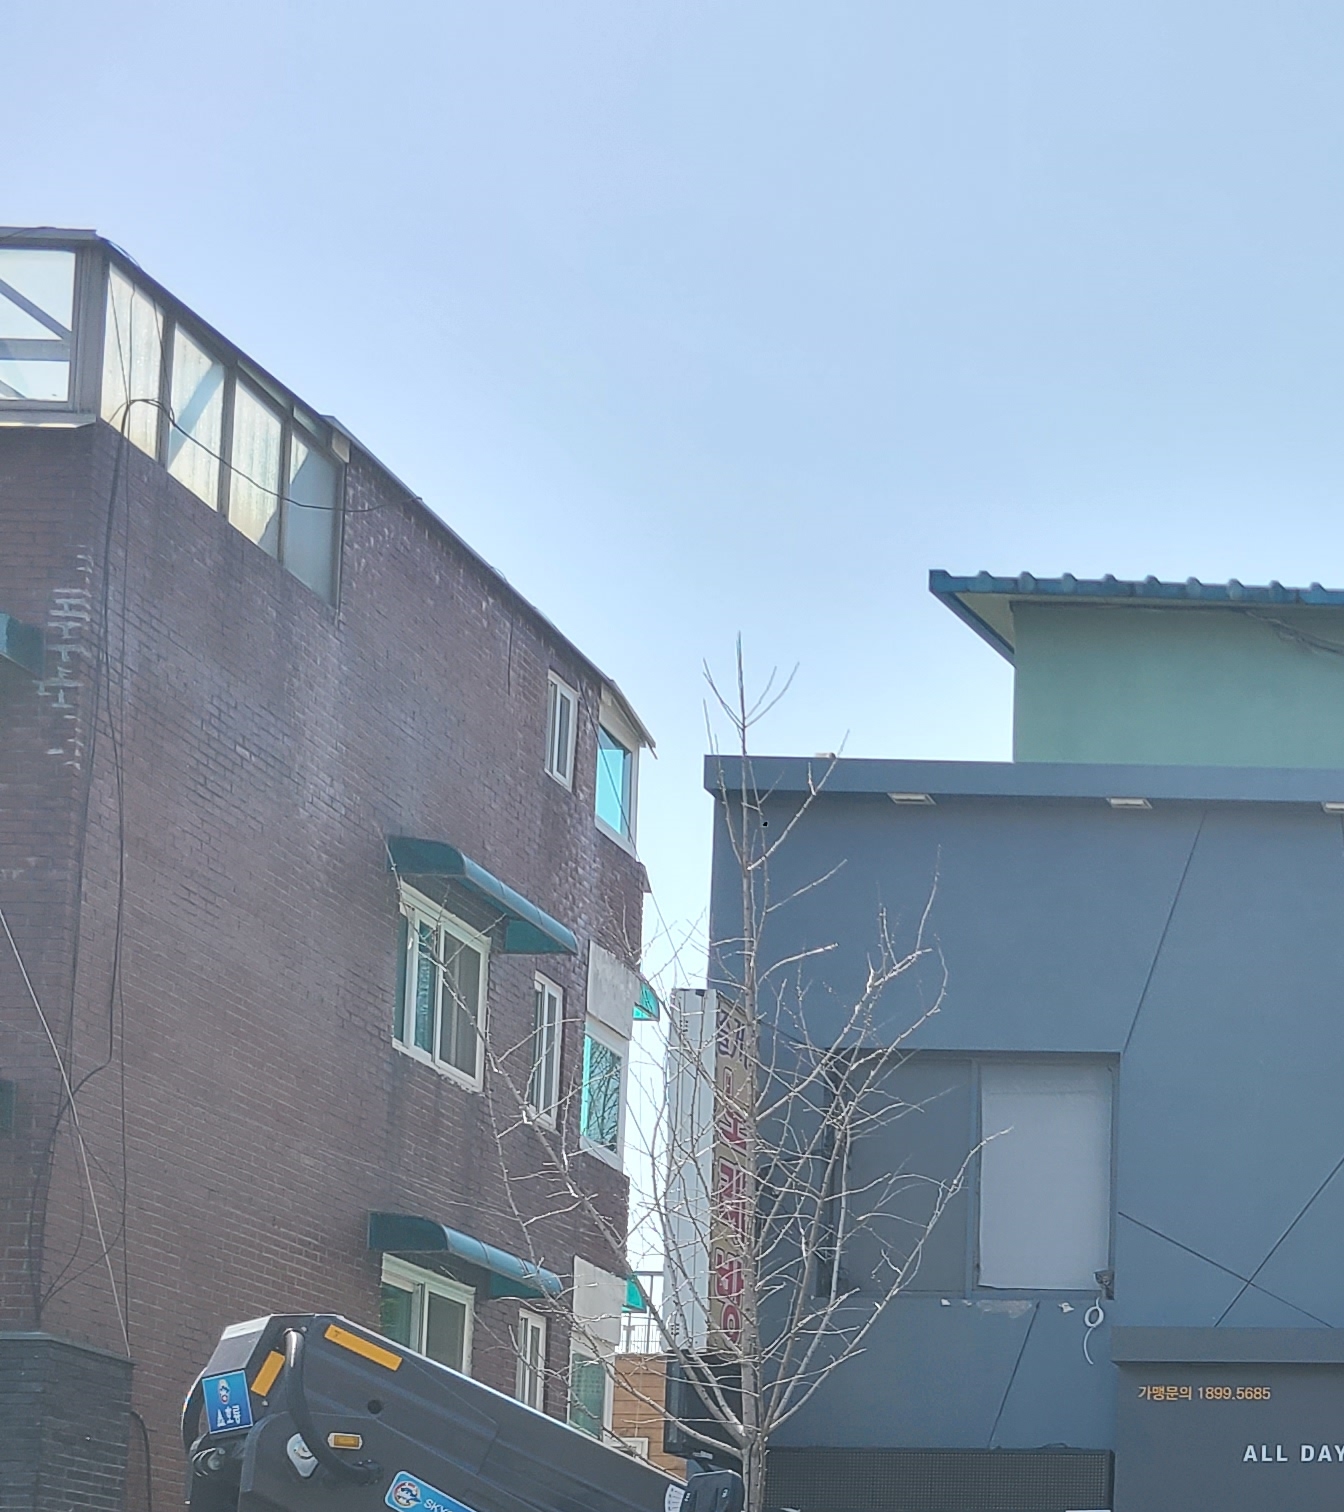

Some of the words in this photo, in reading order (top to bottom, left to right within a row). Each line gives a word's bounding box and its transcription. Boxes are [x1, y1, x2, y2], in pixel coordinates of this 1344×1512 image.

[1138, 1385, 1192, 1401] 가맹문의
[1197, 1386, 1271, 1401] 1899.5685
[1243, 1444, 1288, 1462] ALL
